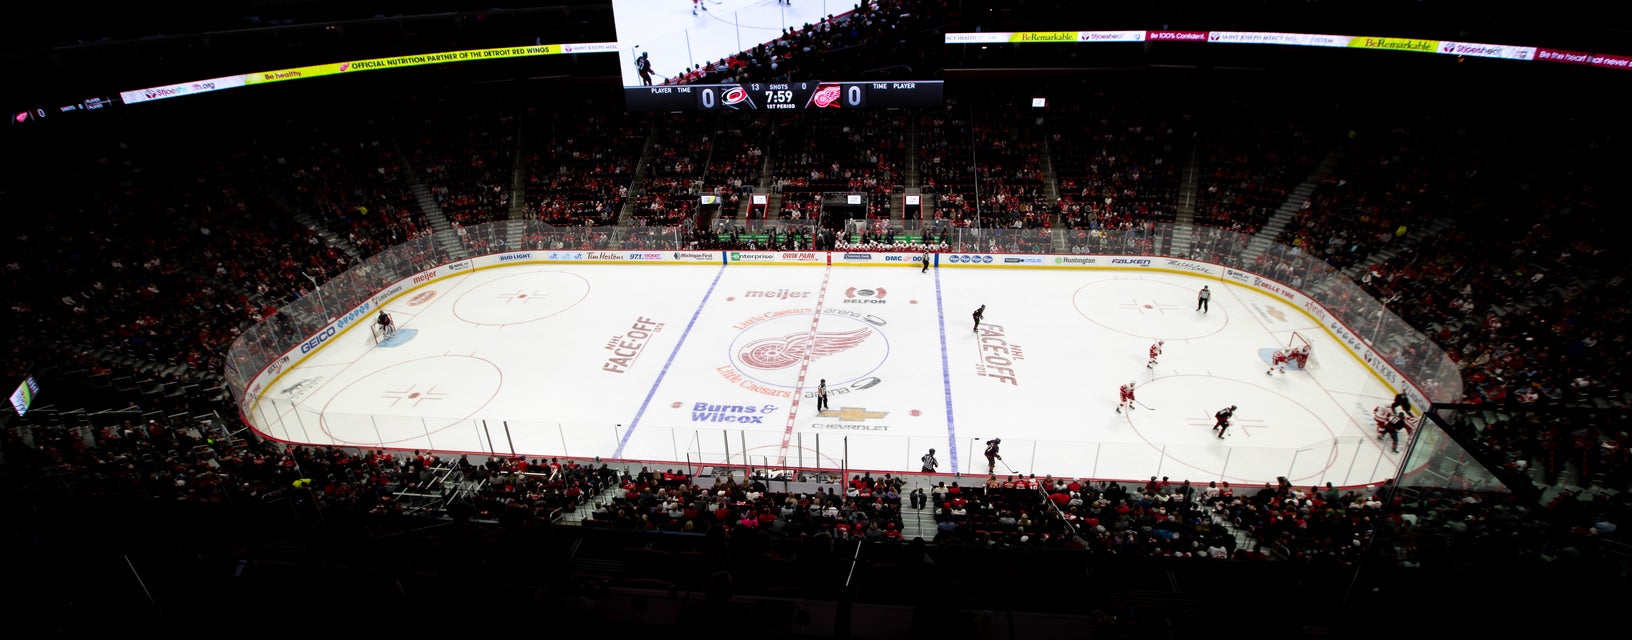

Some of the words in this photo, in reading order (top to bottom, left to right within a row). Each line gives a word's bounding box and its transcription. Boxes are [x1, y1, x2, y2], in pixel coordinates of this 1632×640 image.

[351, 61, 386, 70] OFFICIAL
[387, 57, 425, 66] NUTRITION
[427, 53, 458, 62] PARTNER
[483, 49, 511, 57] DETROIT
[527, 46, 550, 54] WINGS
[801, 82, 807, 90] 0
[702, 88, 715, 109] 0
[765, 91, 793, 103] 7:59
[848, 85, 861, 106] 0
[499, 254, 513, 262] BUD
[513, 253, 531, 261] LIGHT
[587, 252, 599, 260] Tim
[600, 252, 624, 260] Hortons
[1063, 257, 1096, 265] Huntington
[412, 270, 437, 285] meijer
[744, 288, 811, 300] meijer
[1305, 300, 1327, 321] xfinity
[732, 315, 765, 331] Little
[763, 308, 812, 318] Caesars
[824, 307, 862, 318] arena
[301, 326, 336, 354] GEICO
[602, 316, 656, 373] FACE-OFF
[604, 335, 623, 350] NHL
[978, 322, 1018, 386] FACE-OFF
[1009, 344, 1024, 361] NHL
[716, 364, 742, 384] Little
[740, 379, 792, 398] Caesars
[693, 402, 757, 413] Burns
[760, 404, 778, 414] &
[691, 412, 764, 424] Wilcox
[812, 423, 890, 431] CHEVROLET
